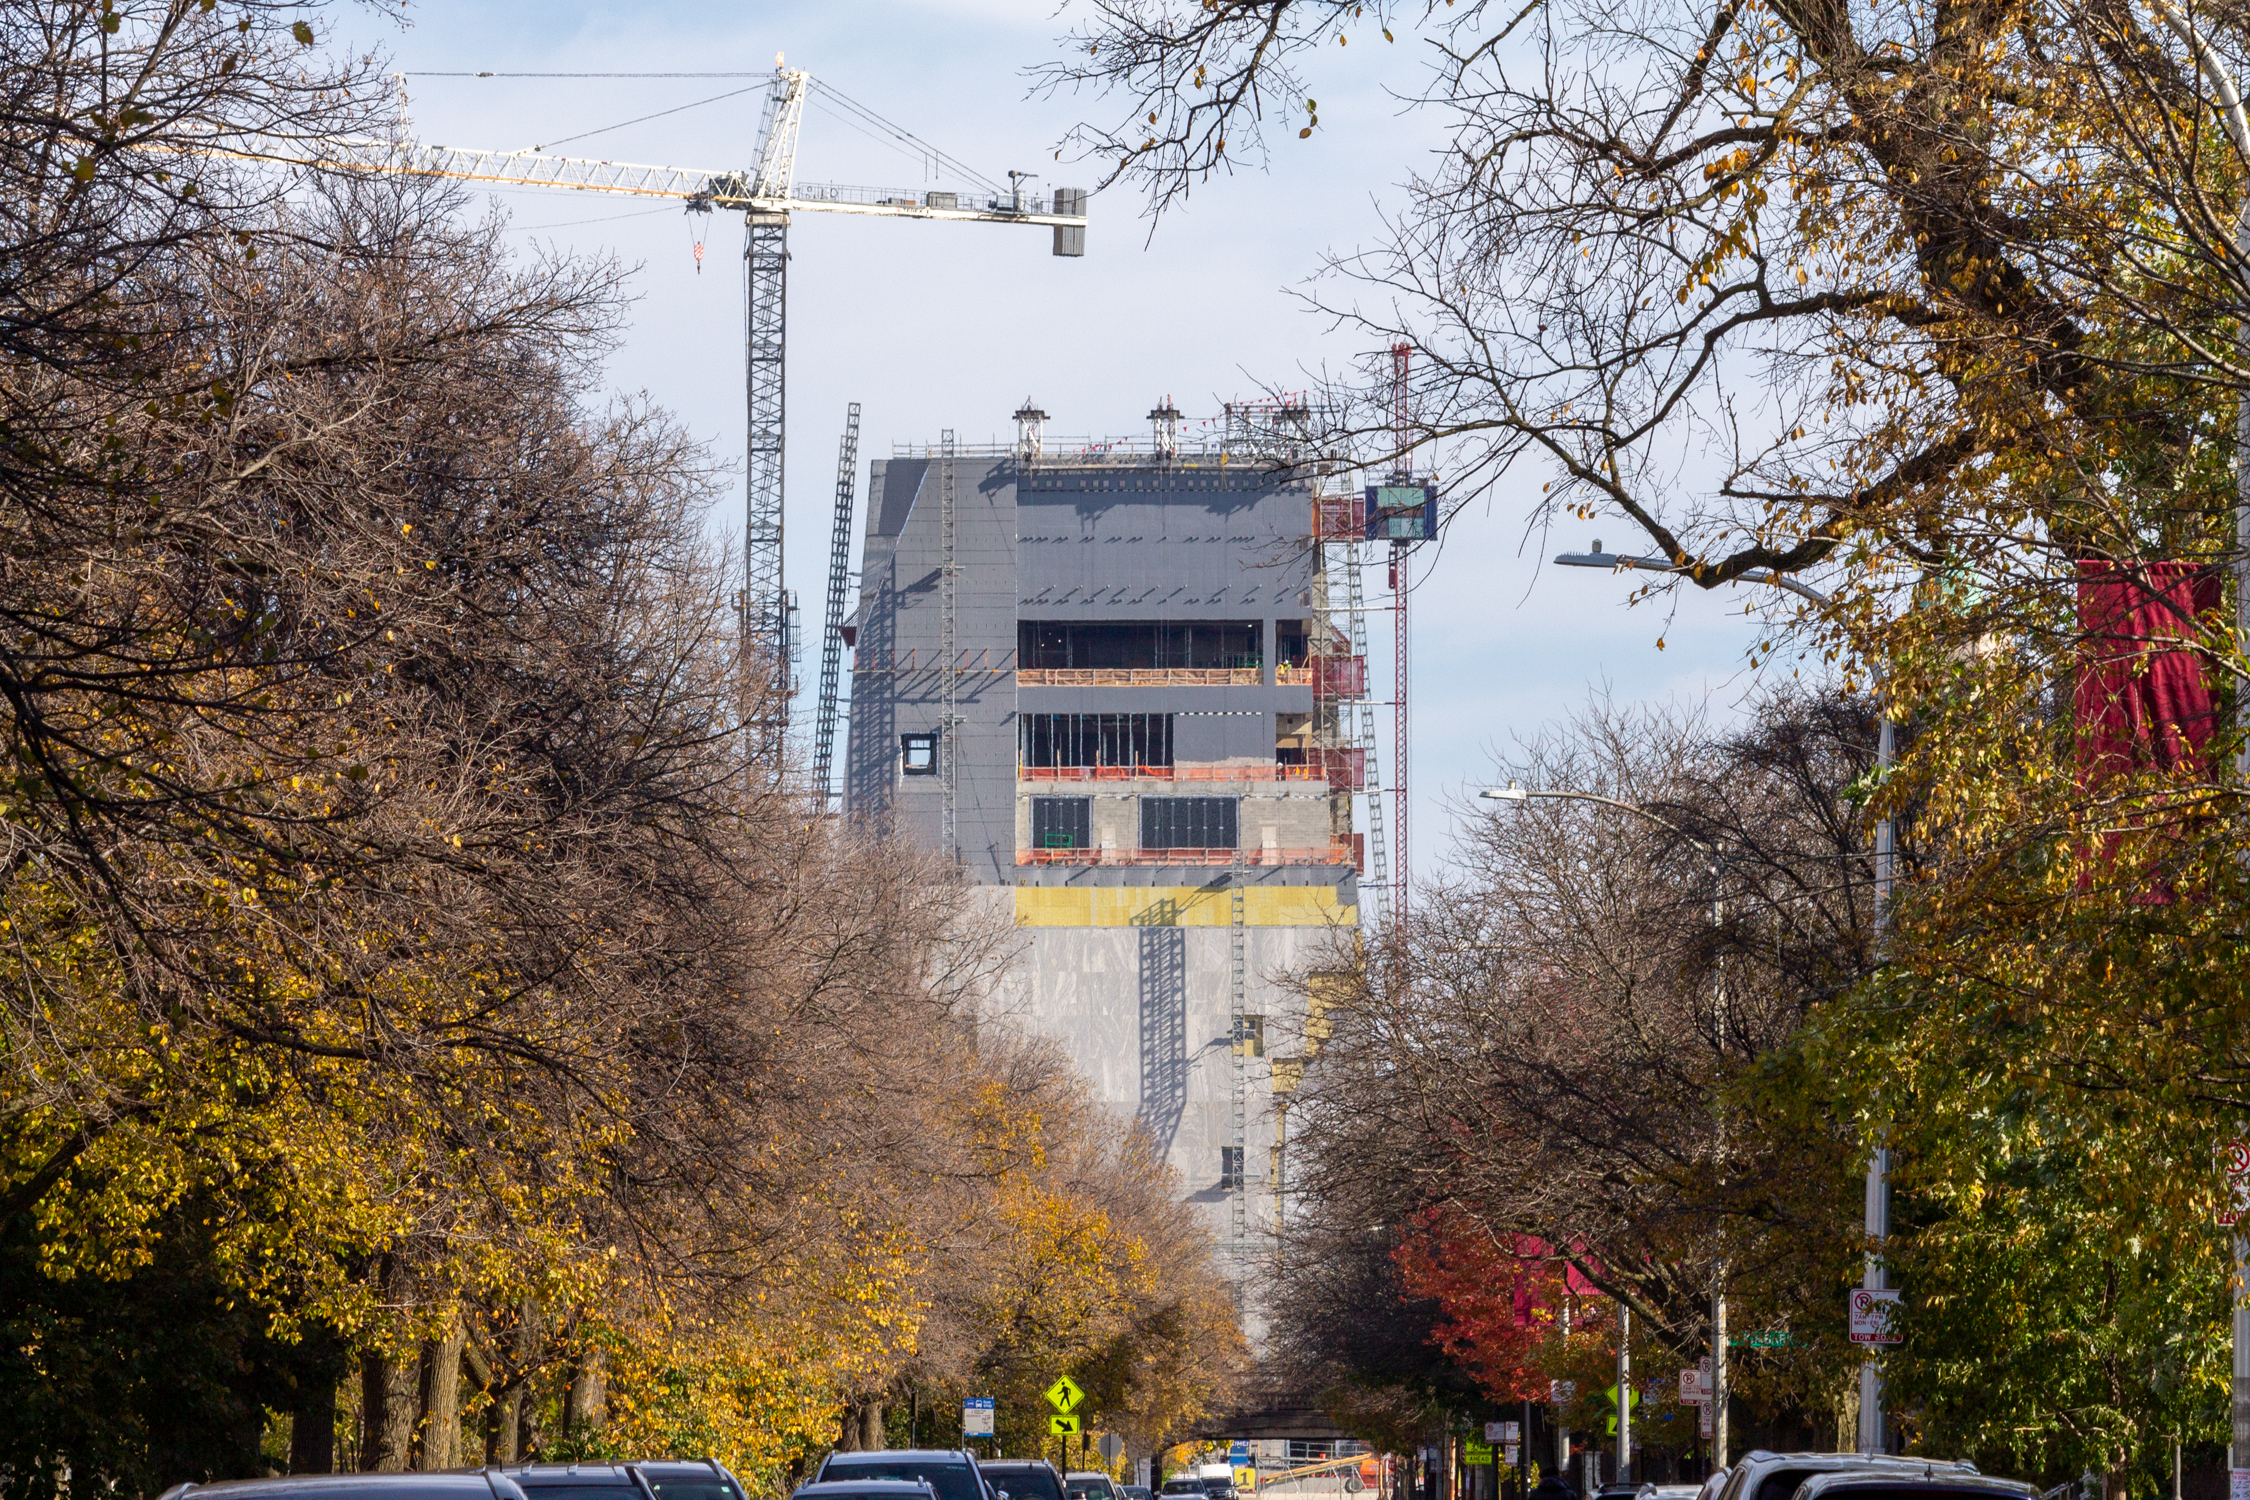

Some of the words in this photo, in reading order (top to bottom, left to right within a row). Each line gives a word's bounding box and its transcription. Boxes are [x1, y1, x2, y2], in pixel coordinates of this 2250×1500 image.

[1853, 1333, 1871, 1341] TOW
[1874, 1333, 1897, 1341] ZO
[1240, 1472, 1249, 1486] 1
